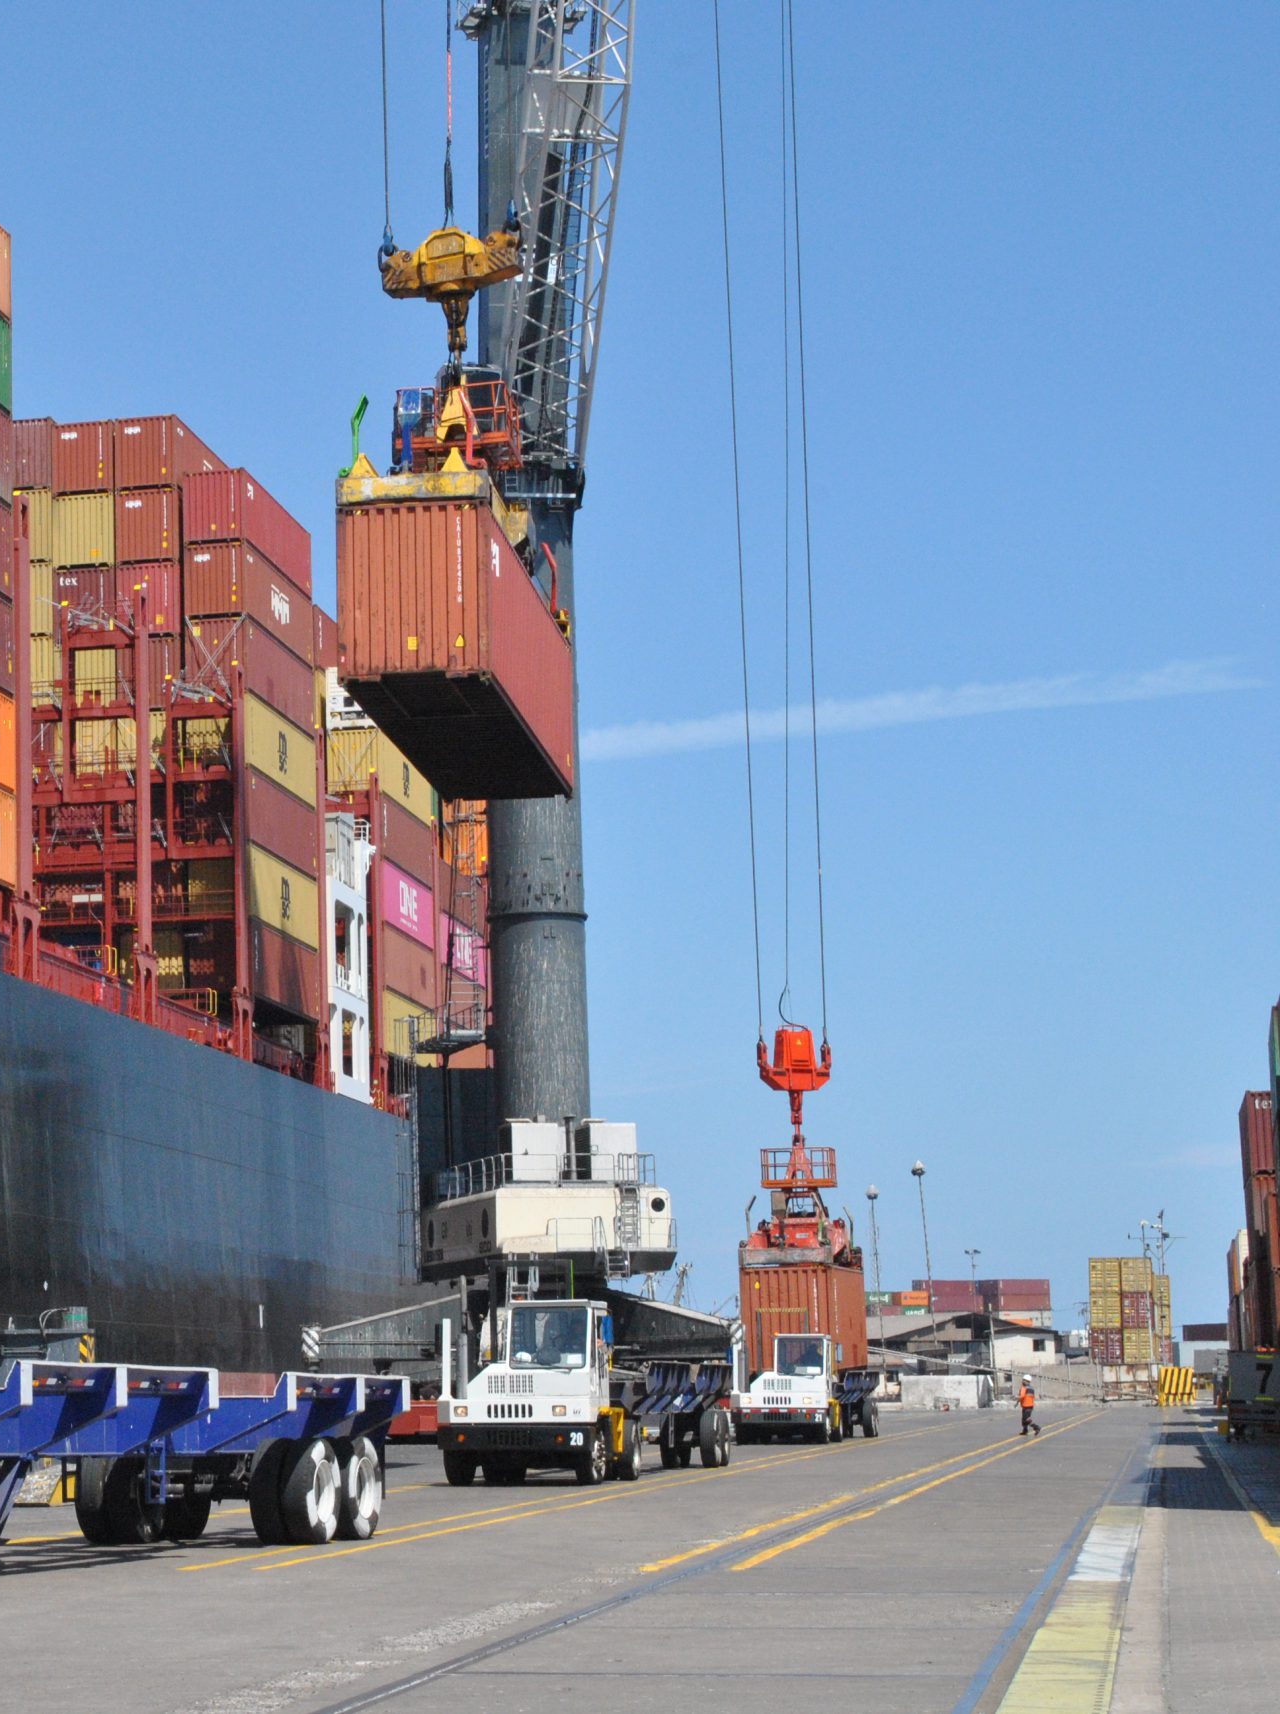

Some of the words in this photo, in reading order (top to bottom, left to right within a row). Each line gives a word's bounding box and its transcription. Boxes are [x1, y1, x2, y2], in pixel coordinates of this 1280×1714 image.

[59, 576, 78, 586] tex
[1256, 1363, 1273, 1395] 7
[570, 1432, 584, 1446] 20
